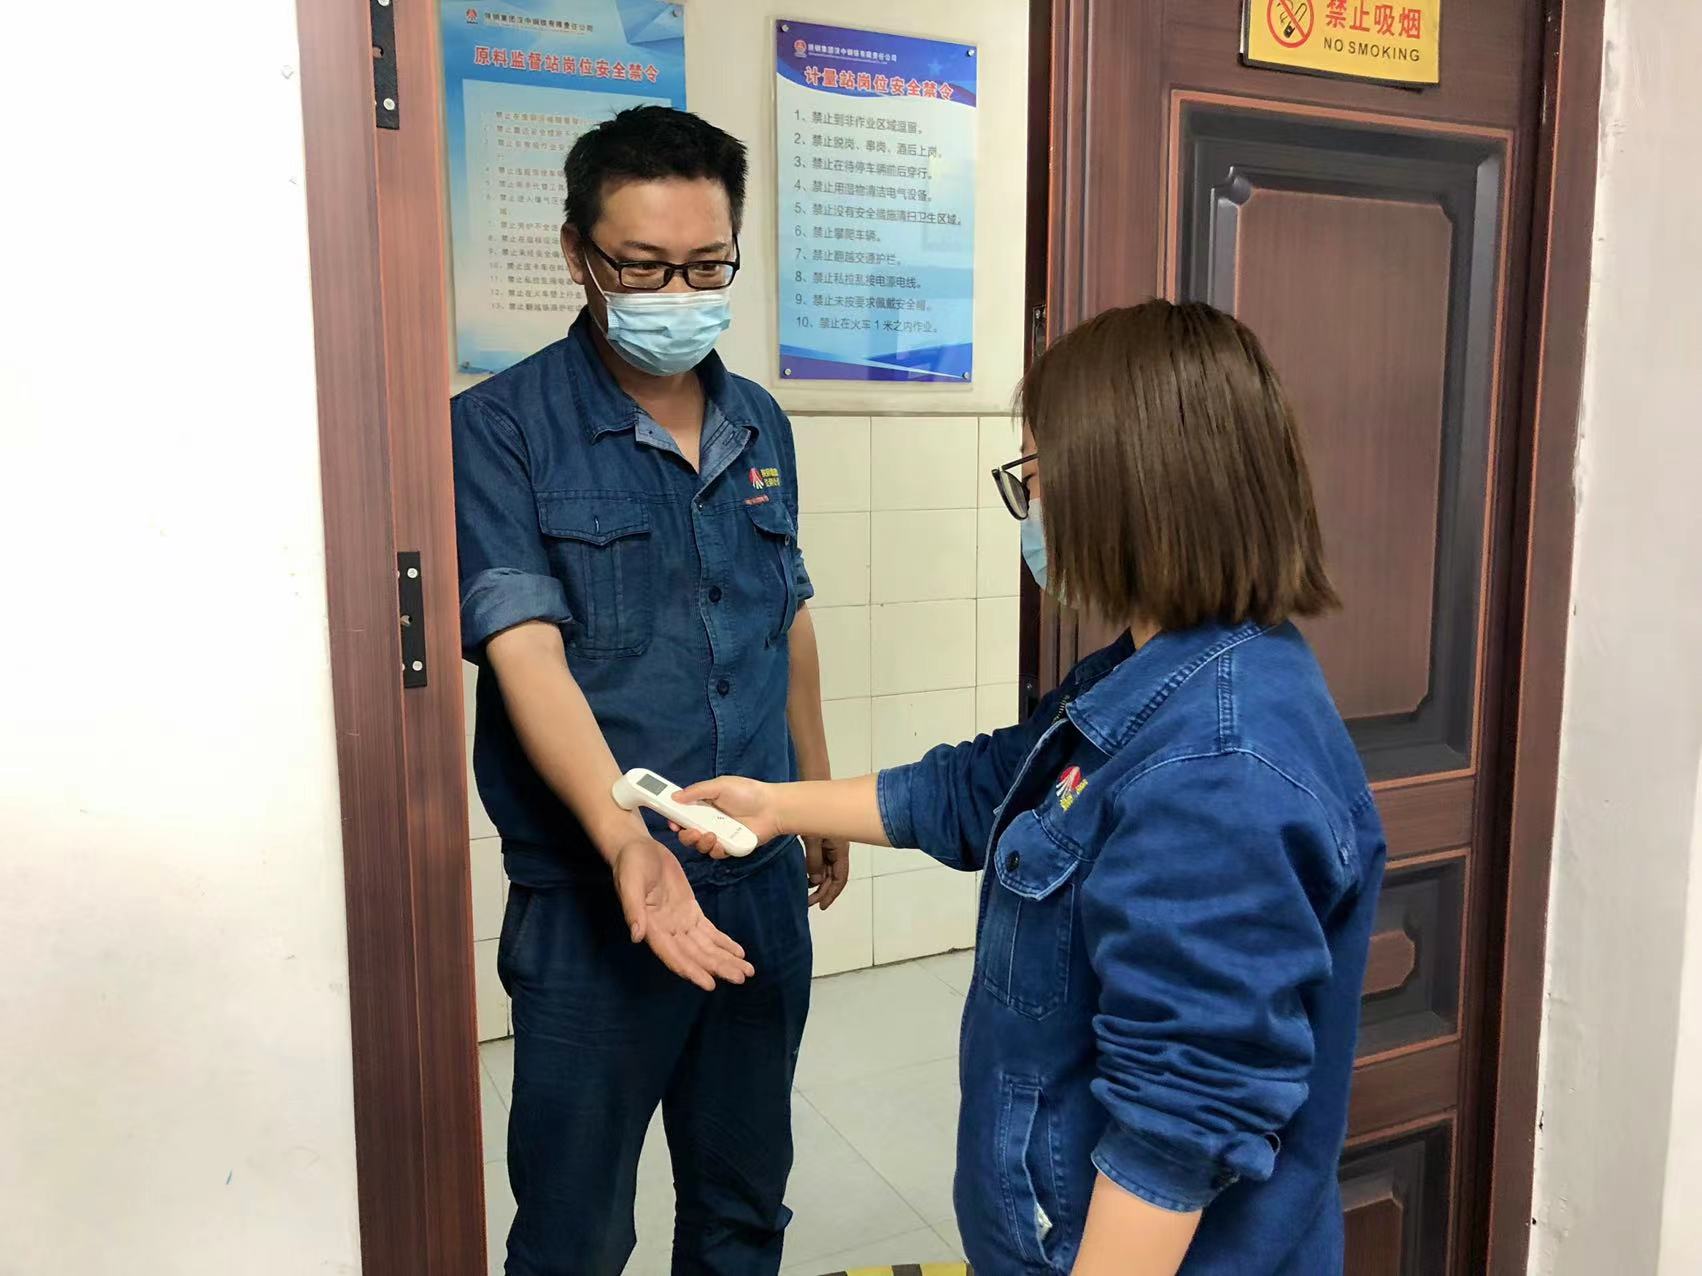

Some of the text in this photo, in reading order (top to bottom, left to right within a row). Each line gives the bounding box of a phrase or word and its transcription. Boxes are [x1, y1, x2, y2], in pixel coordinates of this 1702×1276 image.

[1325, 0, 1422, 40] 禁止吸烟
[474, 46, 660, 83] 原料监督站岗位安全禁令
[1324, 37, 1420, 62] NO SMOKING
[805, 66, 954, 100] 计量站岗位安全禁令
